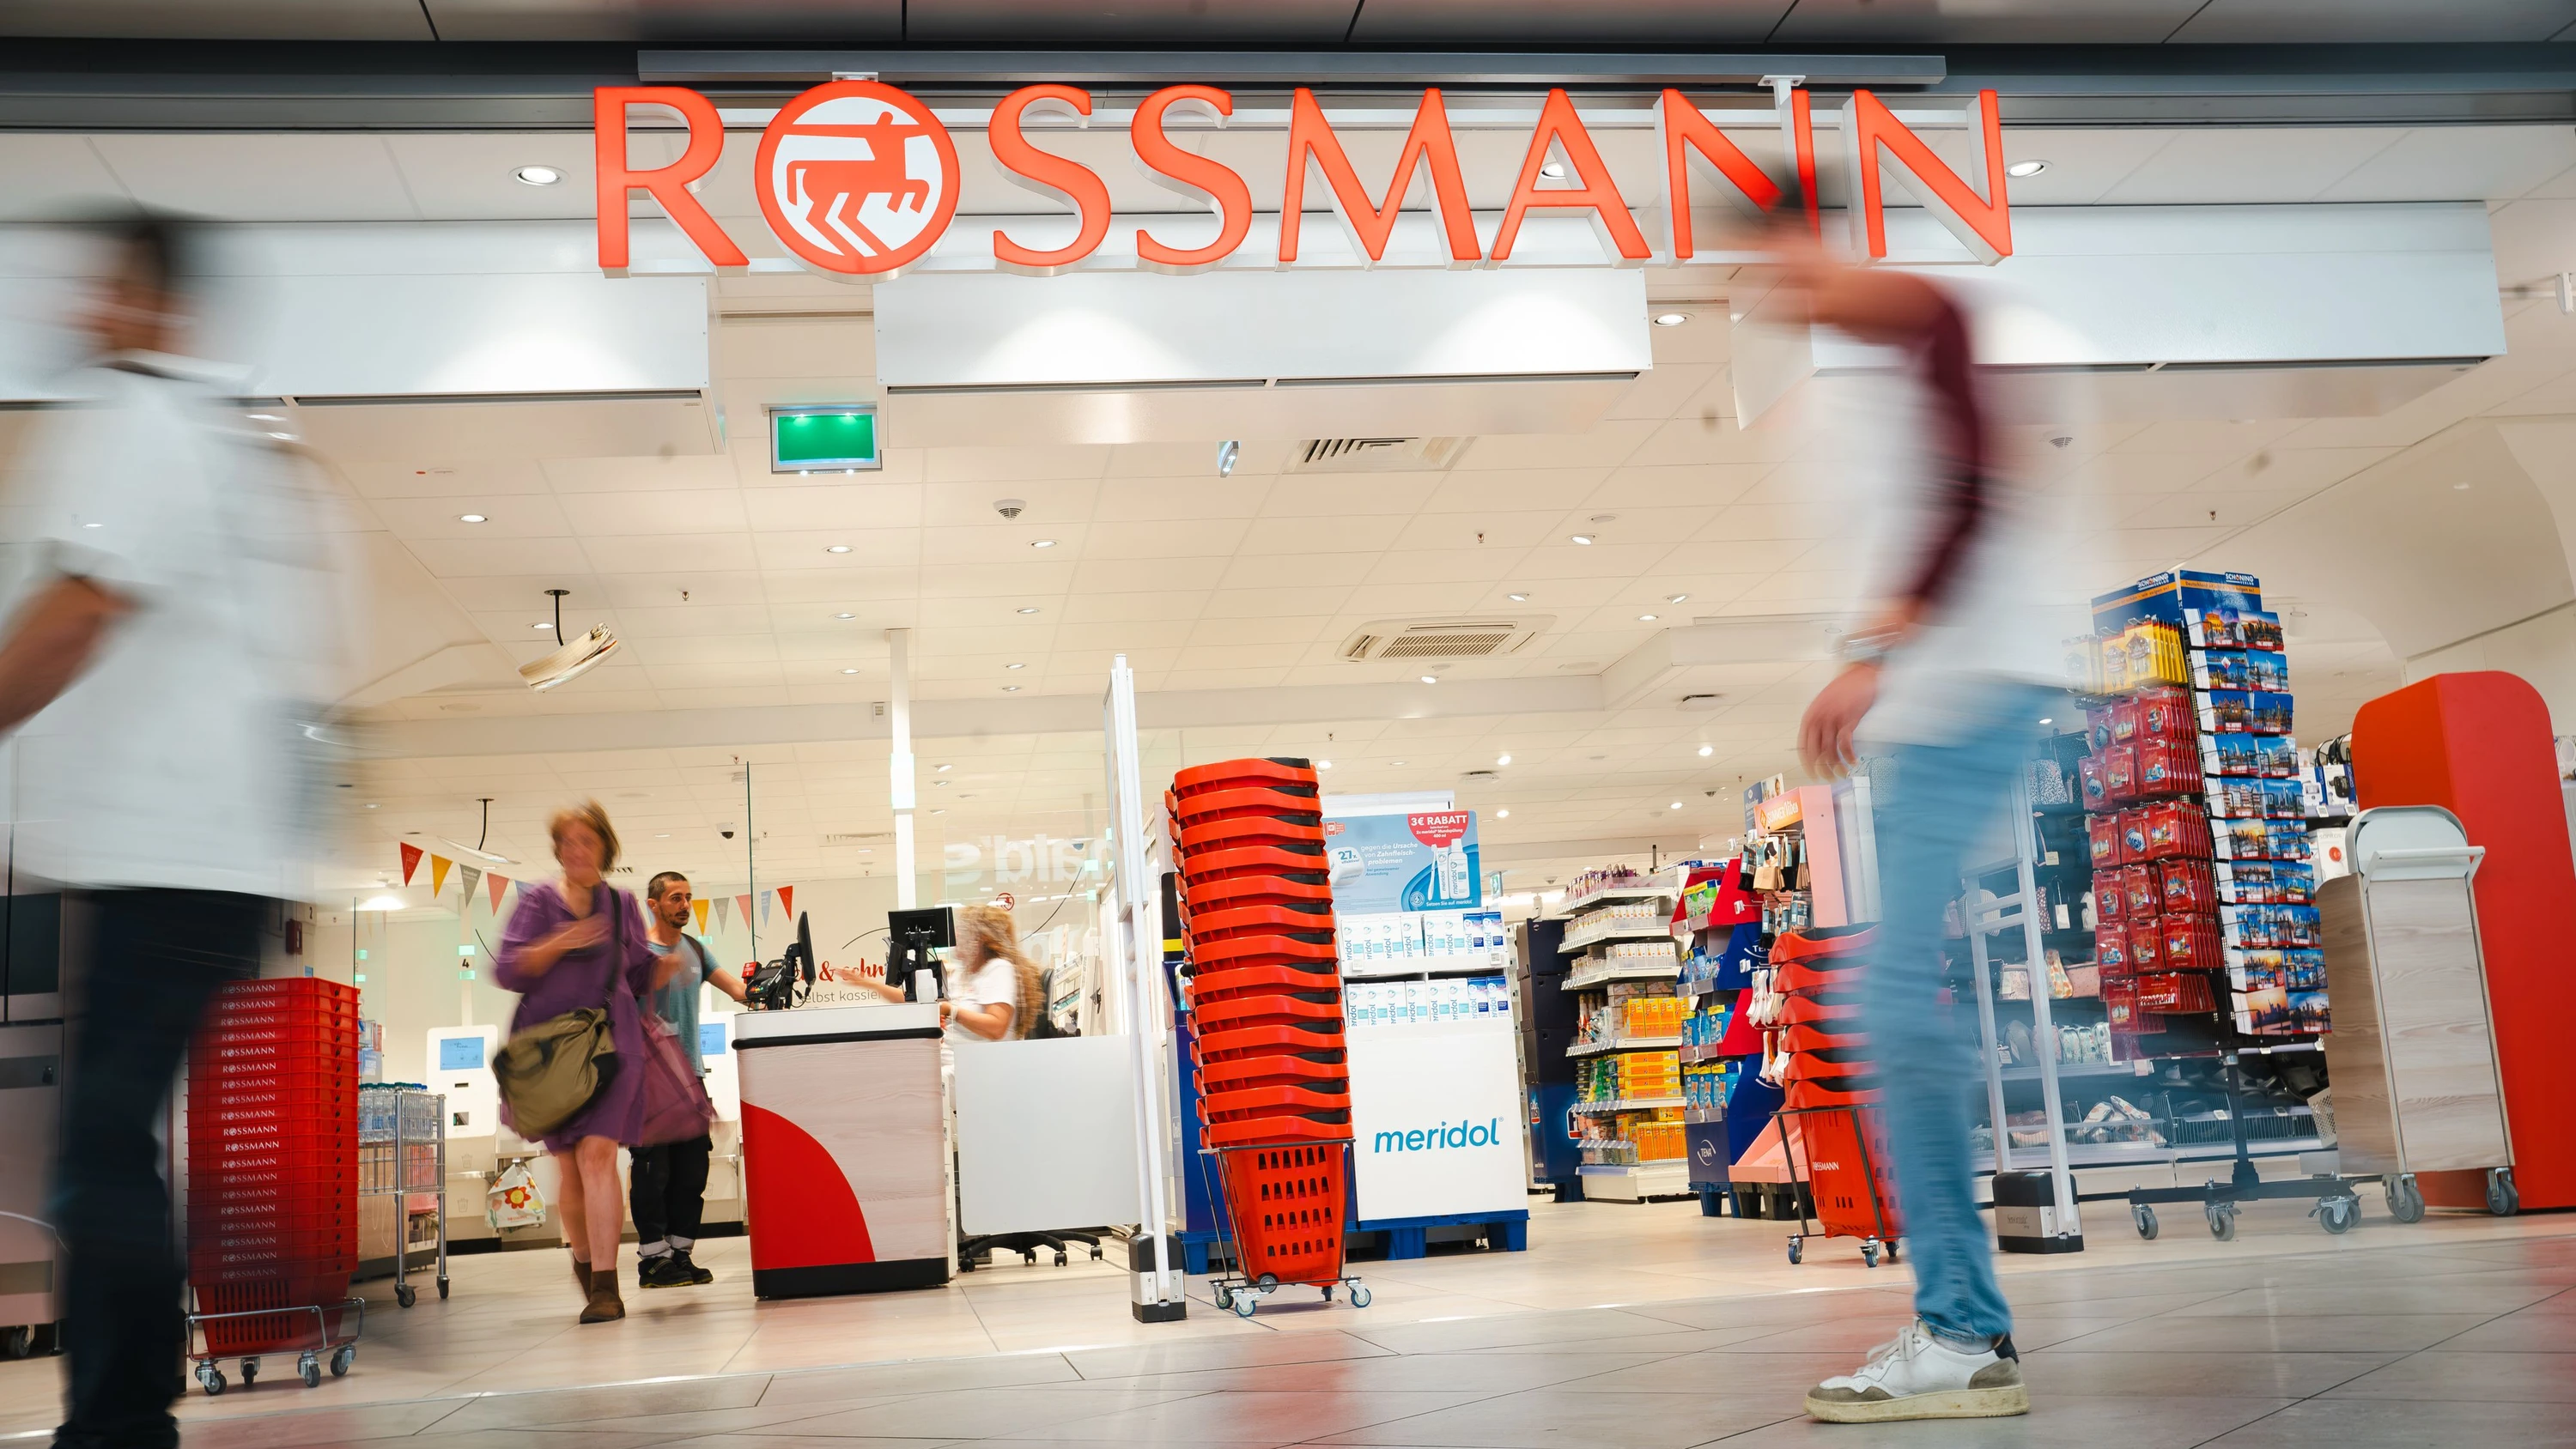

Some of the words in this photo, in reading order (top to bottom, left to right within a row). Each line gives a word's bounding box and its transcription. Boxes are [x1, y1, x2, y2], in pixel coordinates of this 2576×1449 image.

[594, 80, 2013, 276] ROSSMANN
[1411, 816, 1425, 827] 3€
[1427, 815, 1467, 826] RABATT
[1376, 849, 1416, 858] Zahnfleisch-
[1367, 858, 1403, 866] problemen
[462, 958, 470, 968] 4
[222, 1000, 276, 1010] ROSSMANN
[221, 1016, 275, 1026] ROSSMANN
[222, 1031, 276, 1042] ROSSMANN
[221, 1046, 276, 1058] ROSSMANN
[222, 1062, 276, 1073] ROSSMANN
[222, 1078, 276, 1089] ROSSMANN
[222, 1094, 276, 1105] ROSSMANN
[221, 1109, 275, 1120] ROSSMANN
[223, 1125, 277, 1137] ROSSMANN
[225, 1141, 280, 1152] ROSSMANN
[1700, 1148, 1712, 1158] TENA
[222, 1157, 276, 1169] ROSSMANN
[222, 1173, 277, 1184] ROSSMANN
[222, 1188, 277, 1199] ROSSMANN
[221, 1204, 276, 1216] ROSSMANN
